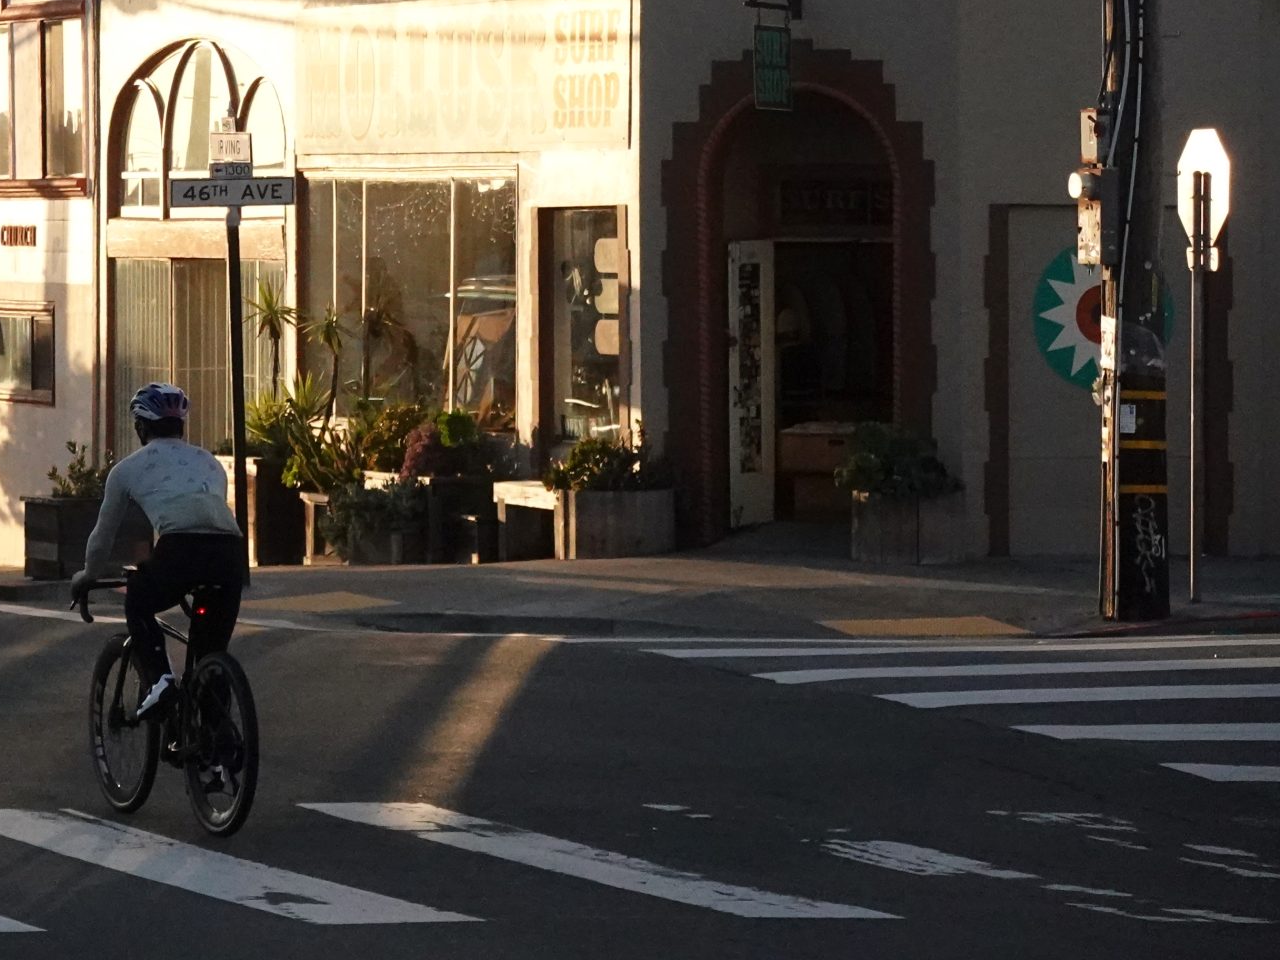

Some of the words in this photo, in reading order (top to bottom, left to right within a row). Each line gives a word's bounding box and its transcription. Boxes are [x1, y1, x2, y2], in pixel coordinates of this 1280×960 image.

[554, 10, 621, 65] SURF
[304, 17, 548, 141] MOLLUSK
[553, 72, 620, 129] SHOP
[218, 139, 241, 155] IRVING
[225, 165, 250, 176] 1300
[182, 185, 228, 201] 46TH
[241, 183, 282, 200] AVE
[0, 225, 37, 246] CHURCH
